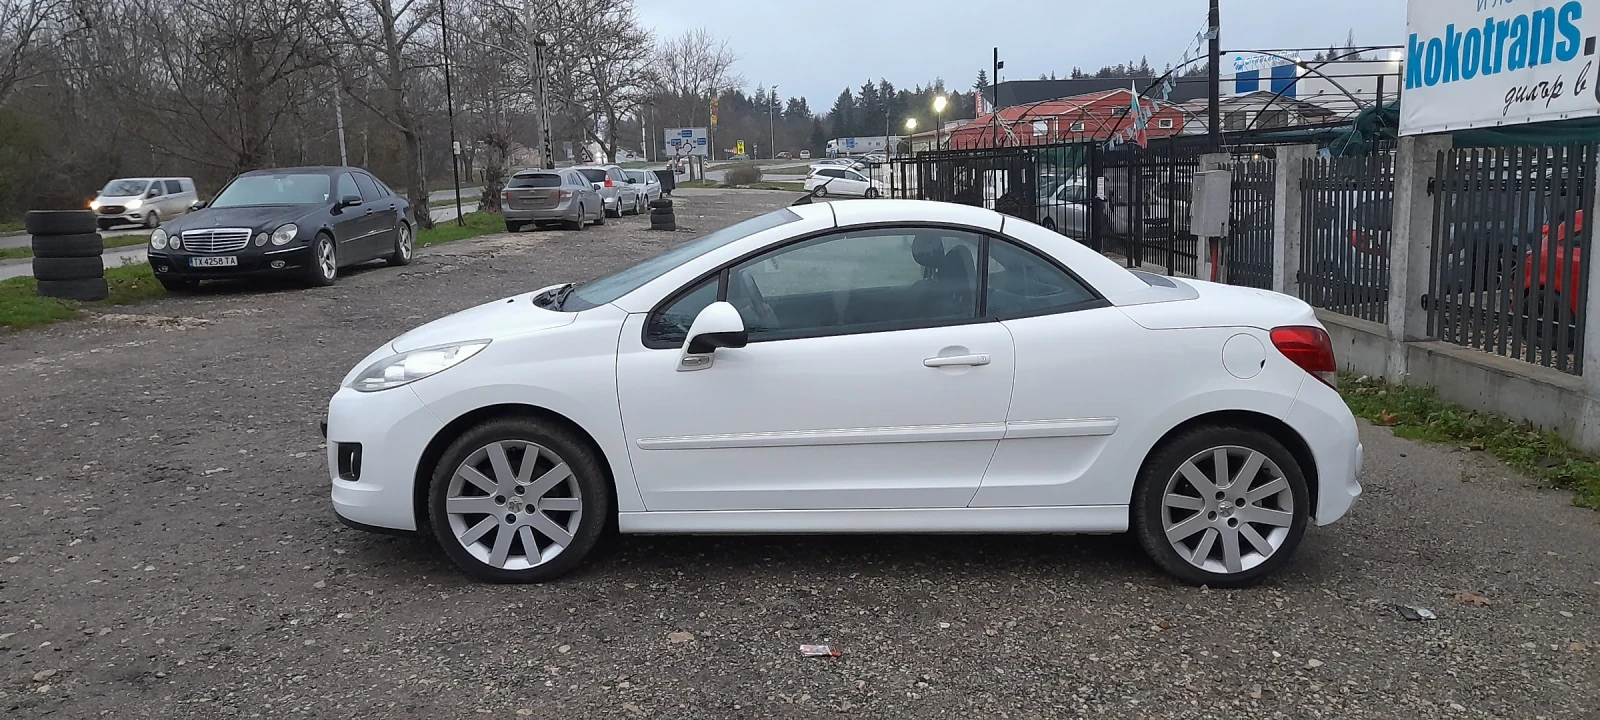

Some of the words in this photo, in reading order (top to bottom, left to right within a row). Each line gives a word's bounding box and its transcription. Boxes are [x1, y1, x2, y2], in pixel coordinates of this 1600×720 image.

[1503, 74, 1564, 117] дилър
[204, 257, 224, 266] 4258
[224, 257, 236, 265] TA
